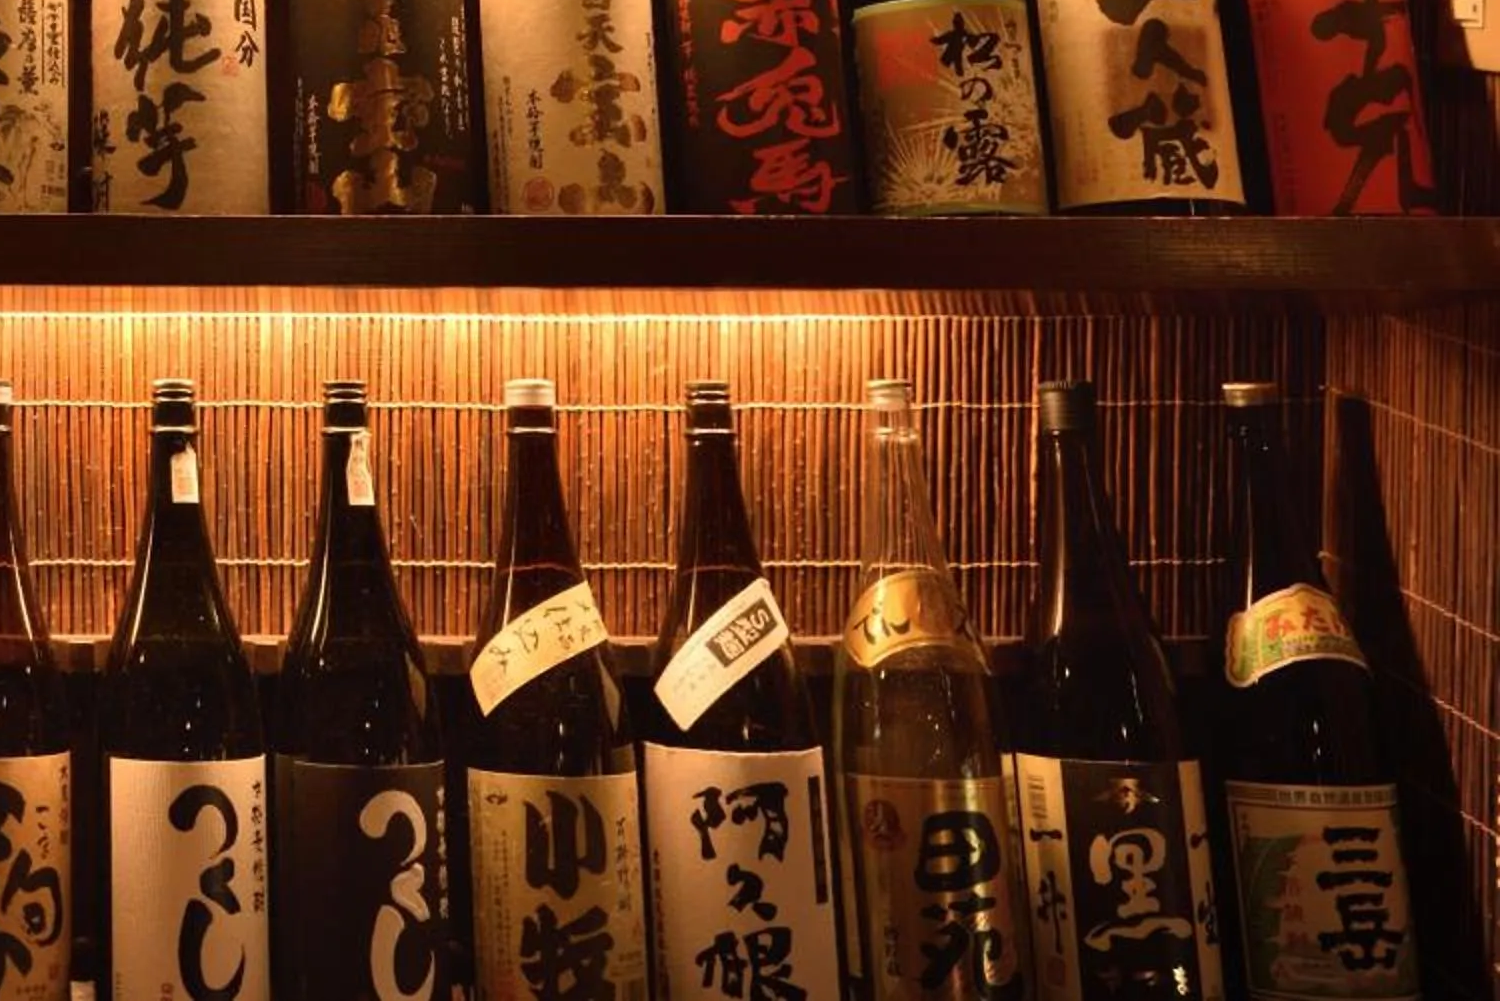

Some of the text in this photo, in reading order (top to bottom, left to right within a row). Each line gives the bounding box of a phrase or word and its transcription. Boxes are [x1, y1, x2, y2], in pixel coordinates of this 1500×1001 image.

[930, 12, 1018, 186] 松の露
[690, 782, 806, 1001] 阿久根
[1317, 826, 1405, 972] 三岳
